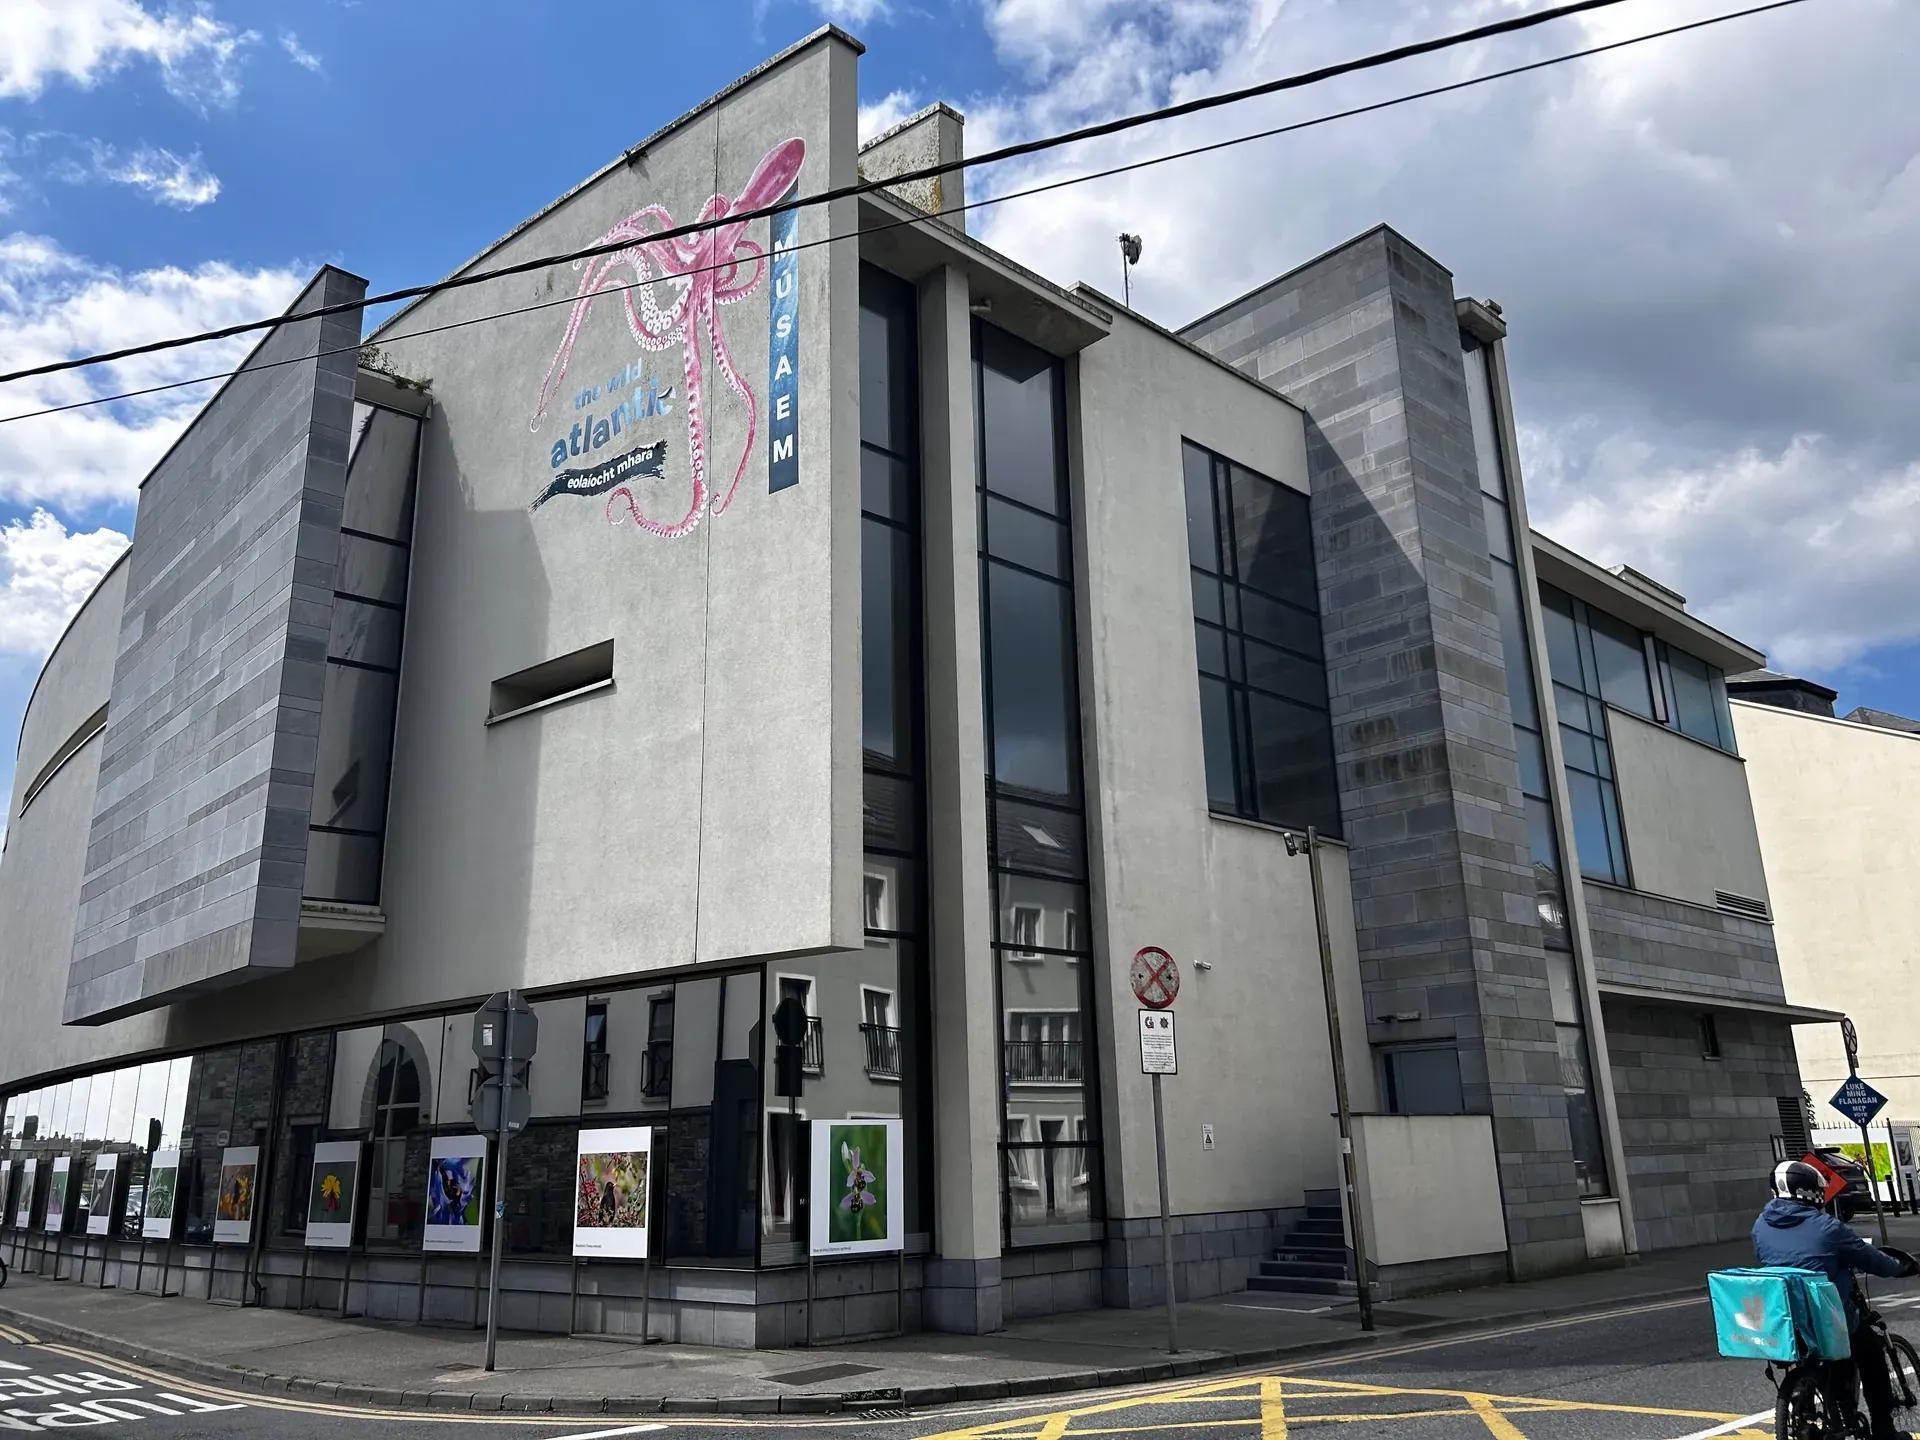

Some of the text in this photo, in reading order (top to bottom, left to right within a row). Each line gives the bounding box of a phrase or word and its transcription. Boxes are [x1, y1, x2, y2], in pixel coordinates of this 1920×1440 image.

[773, 234, 793, 464] MÚSAEM
[575, 357, 642, 410] the wild
[551, 374, 677, 468] atlantic
[567, 449, 653, 489] eolaíocht mhara
[1838, 1097, 1878, 1105] FLANAGAN
